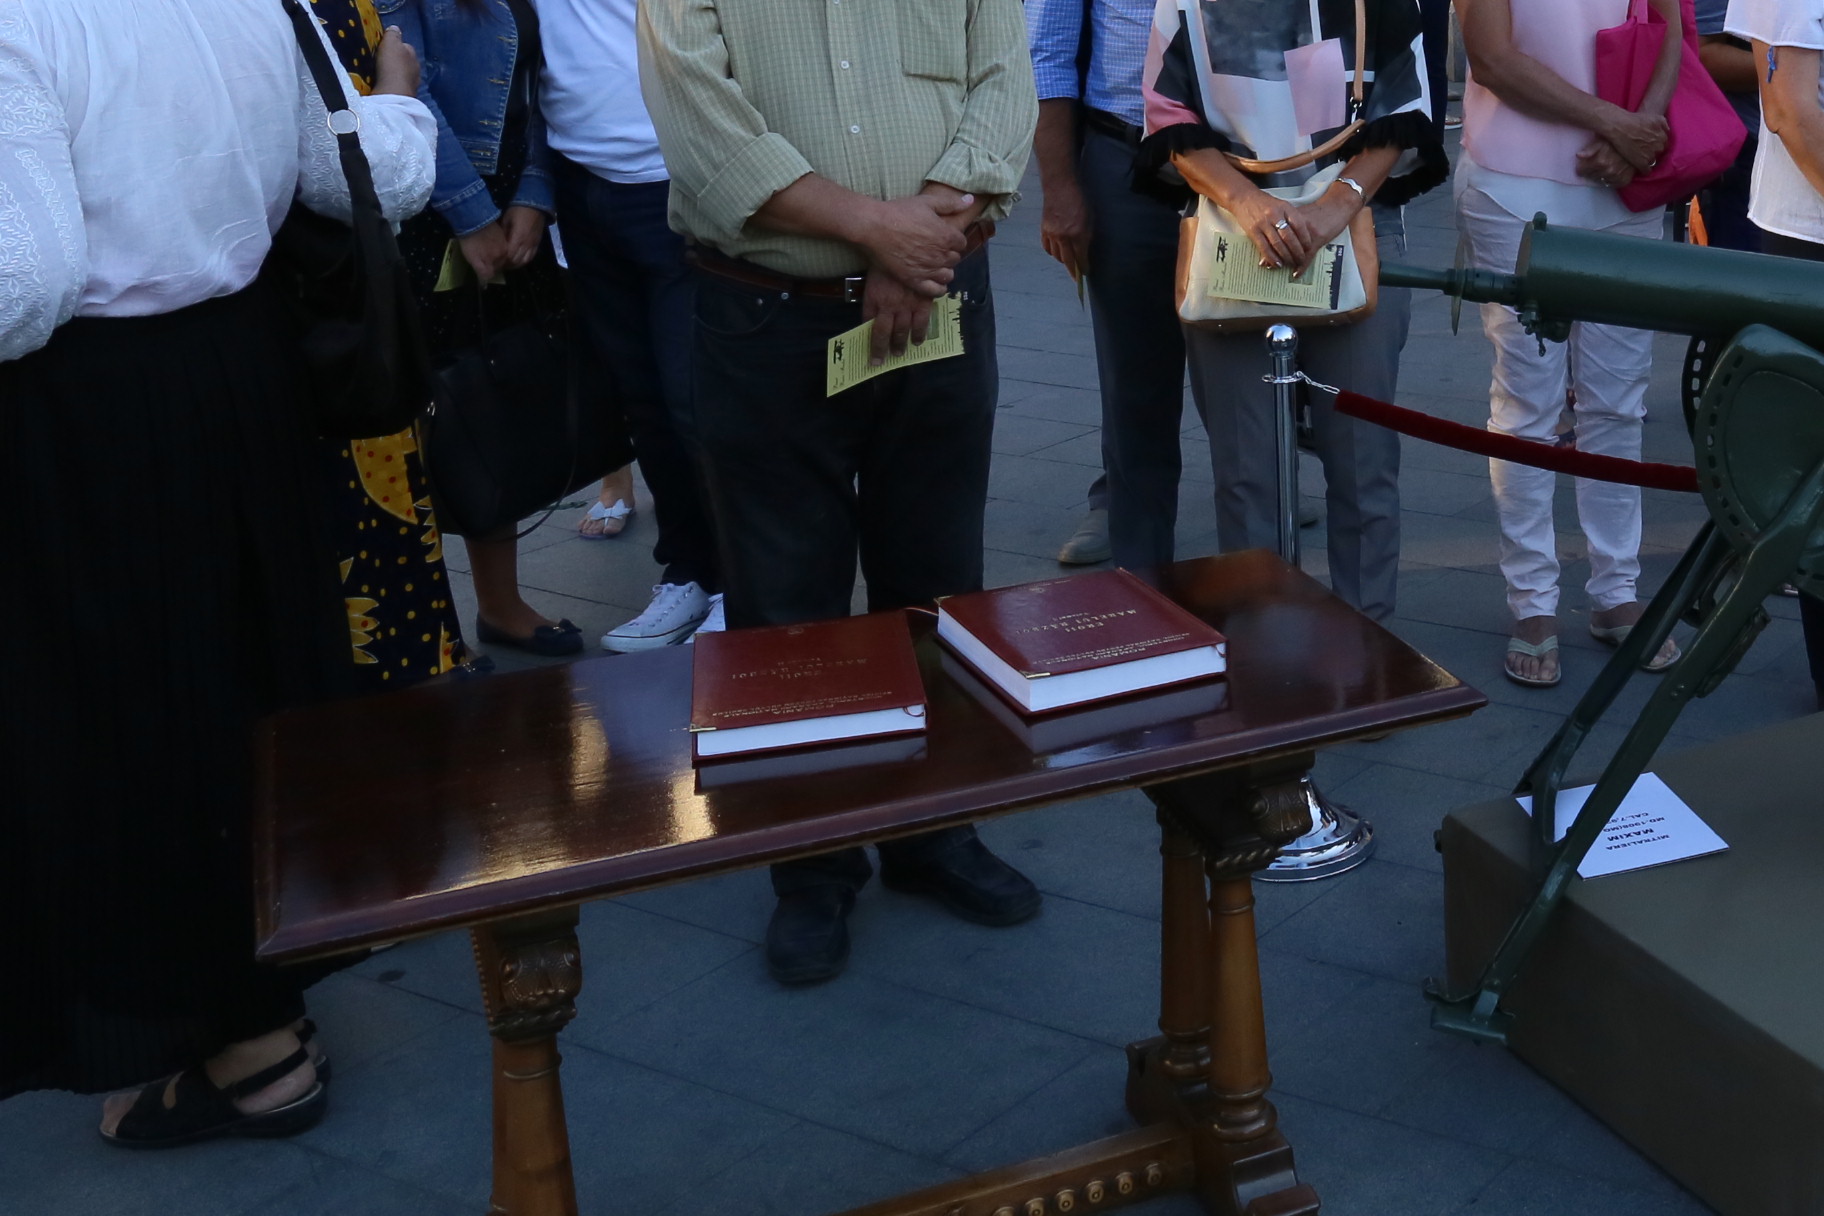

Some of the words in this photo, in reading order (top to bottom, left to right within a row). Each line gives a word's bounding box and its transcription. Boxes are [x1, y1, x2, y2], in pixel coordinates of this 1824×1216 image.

[1072, 609, 1139, 623] MARELUI
[1607, 827, 1655, 842] MAXIM
[1605, 834, 1670, 851] MITRALIERA
